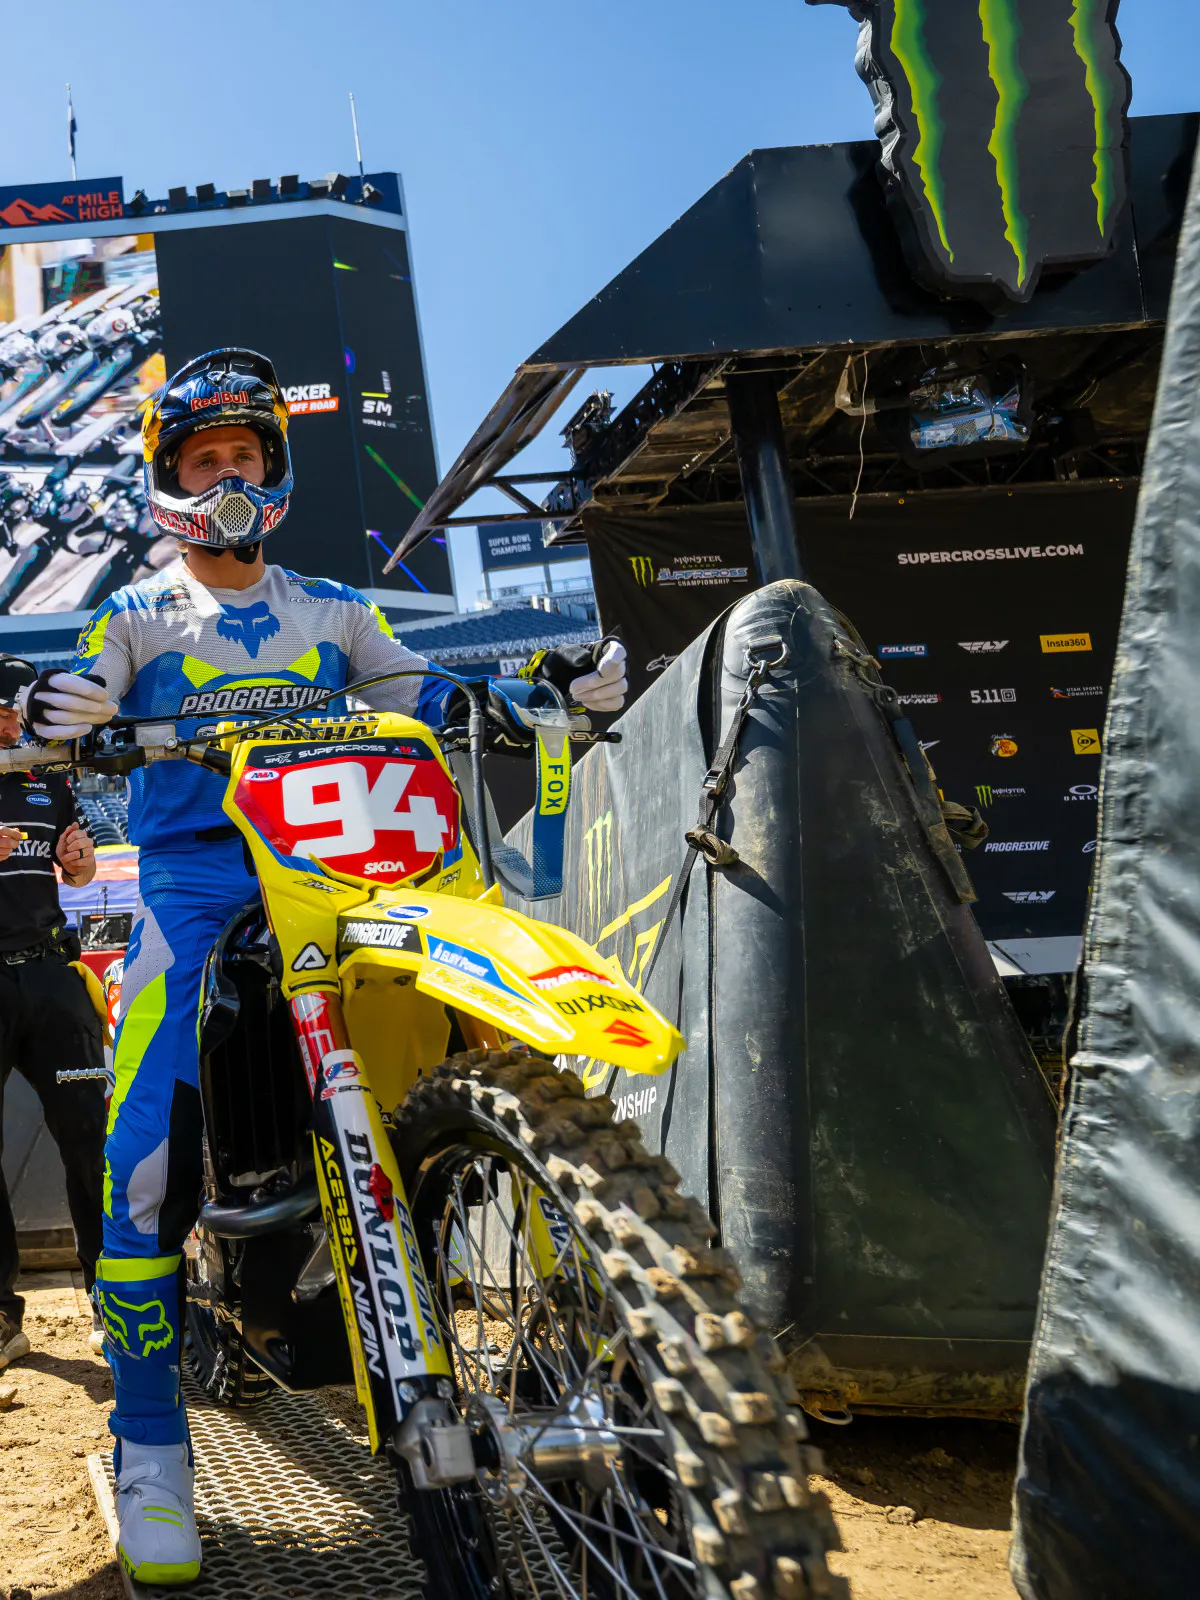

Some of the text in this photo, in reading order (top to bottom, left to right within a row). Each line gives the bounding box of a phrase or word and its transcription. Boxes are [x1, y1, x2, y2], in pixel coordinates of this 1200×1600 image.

[61, 191, 119, 206] AT MILE
[78, 204, 124, 220] HIGH
[280, 383, 331, 402] ACKER
[191, 390, 249, 411] Red Bull
[290, 400, 336, 413] OFF ROAD
[488, 534, 531, 547] SUPER BOWL
[491, 543, 531, 556] CHAMPIONS
[897, 543, 1084, 565] SUPERCROSSLIVE.COM
[674, 555, 722, 564] MONSTER
[657, 567, 748, 581] SUPERCROSS
[881, 645, 925, 653] FALKEN
[1046, 638, 1087, 648] Insta360
[181, 687, 335, 715] PROGRESSIVE
[970, 689, 1001, 704] 5.11
[298, 745, 387, 759] SUPERCROSS
[46, 763, 73, 773] ASV
[249, 771, 274, 780] AMA
[545, 764, 564, 809] FOX
[282, 761, 449, 859] 94
[985, 840, 1050, 853] PROGRESSIVE
[364, 860, 405, 875] SKDA
[342, 922, 413, 947] PROGRESSIVE
[458, 957, 490, 977] Power
[557, 994, 645, 1016] DIXXON
[319, 1136, 357, 1268] ACERBIS
[344, 1129, 417, 1361] DUNLOP
[394, 1195, 441, 1353] ECSTAR
[351, 1274, 385, 1380] NISSIN
